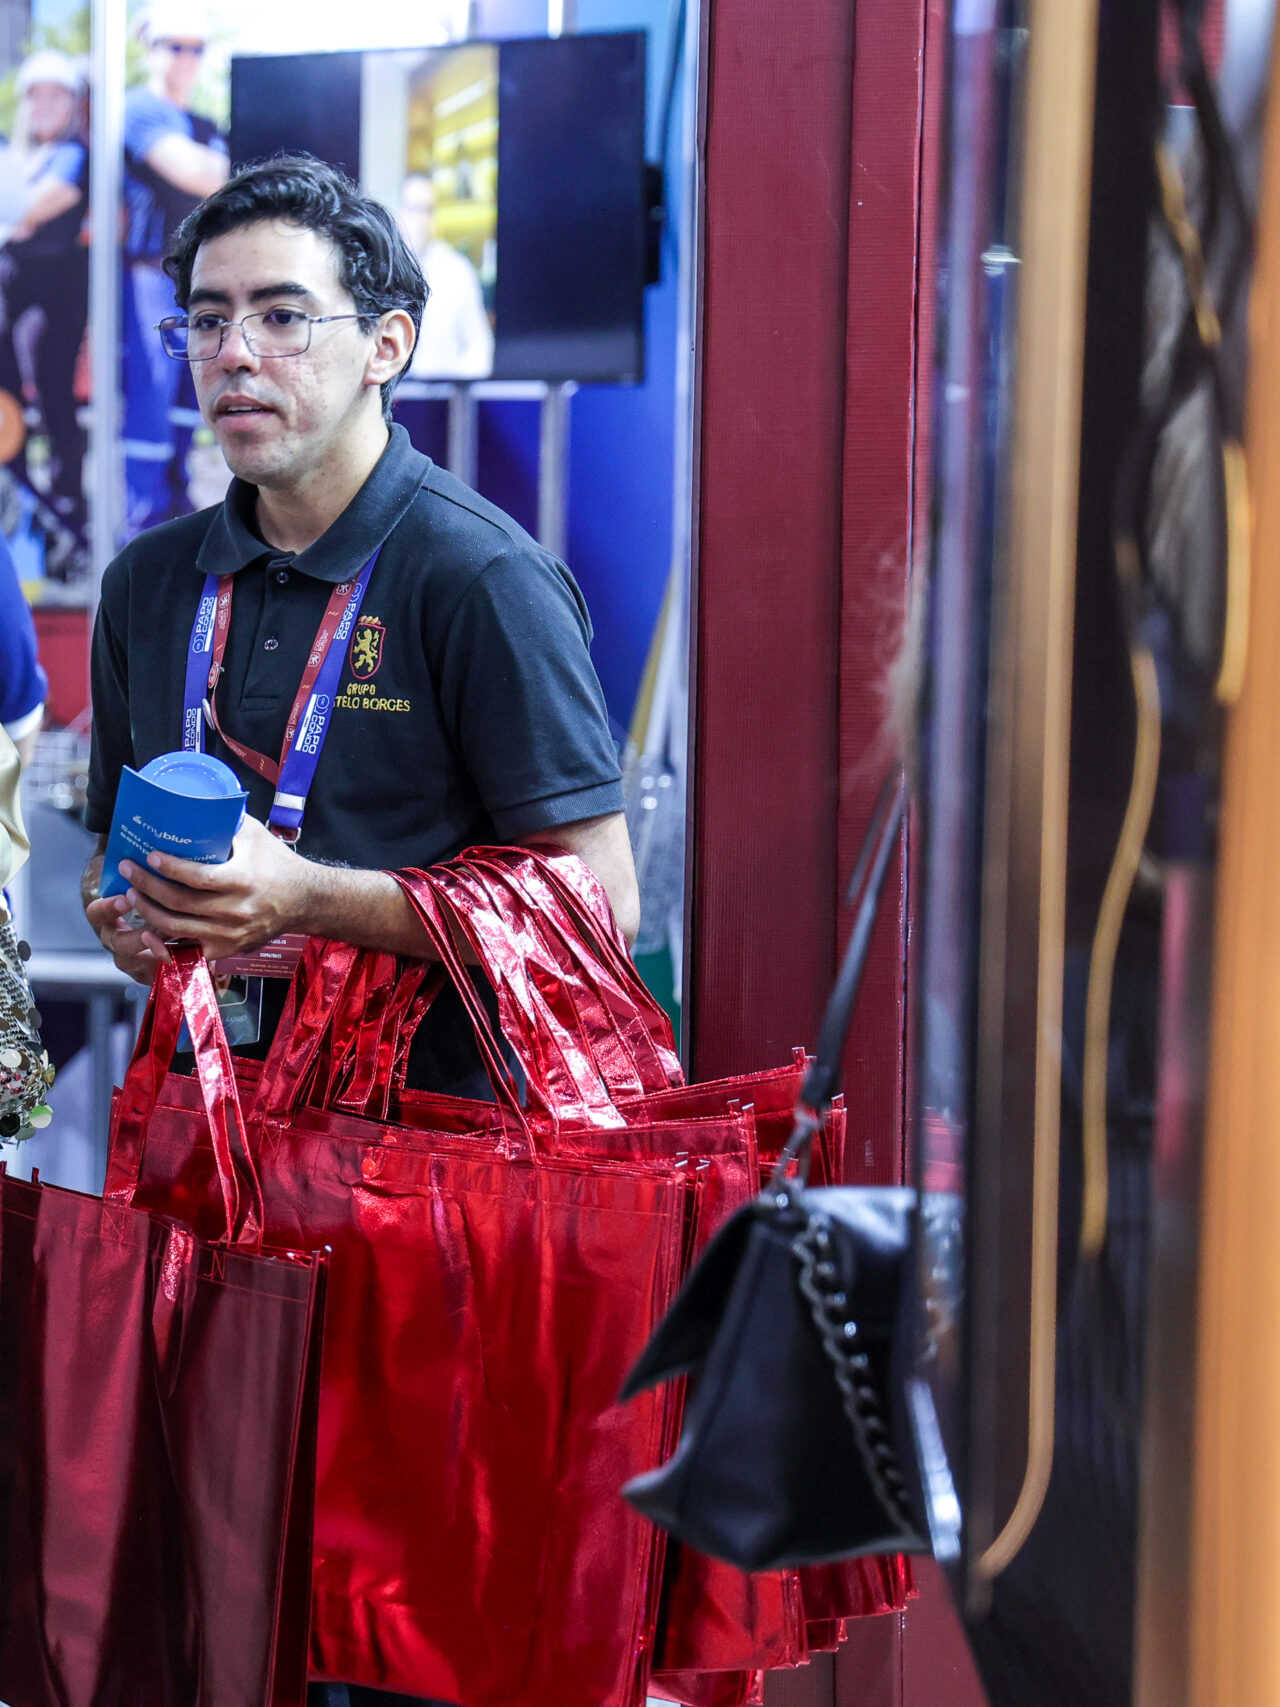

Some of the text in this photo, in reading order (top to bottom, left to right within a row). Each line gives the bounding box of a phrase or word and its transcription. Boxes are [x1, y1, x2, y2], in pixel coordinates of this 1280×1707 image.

[196, 597, 210, 633] PAPO
[202, 596, 215, 632] CONDO
[340, 603, 356, 640] PAPO
[347, 683, 376, 695] GRUPO
[363, 697, 411, 712] BORGES
[302, 714, 318, 753] CONDO
[308, 715, 325, 755] PAPO
[142, 822, 193, 845] myblue
